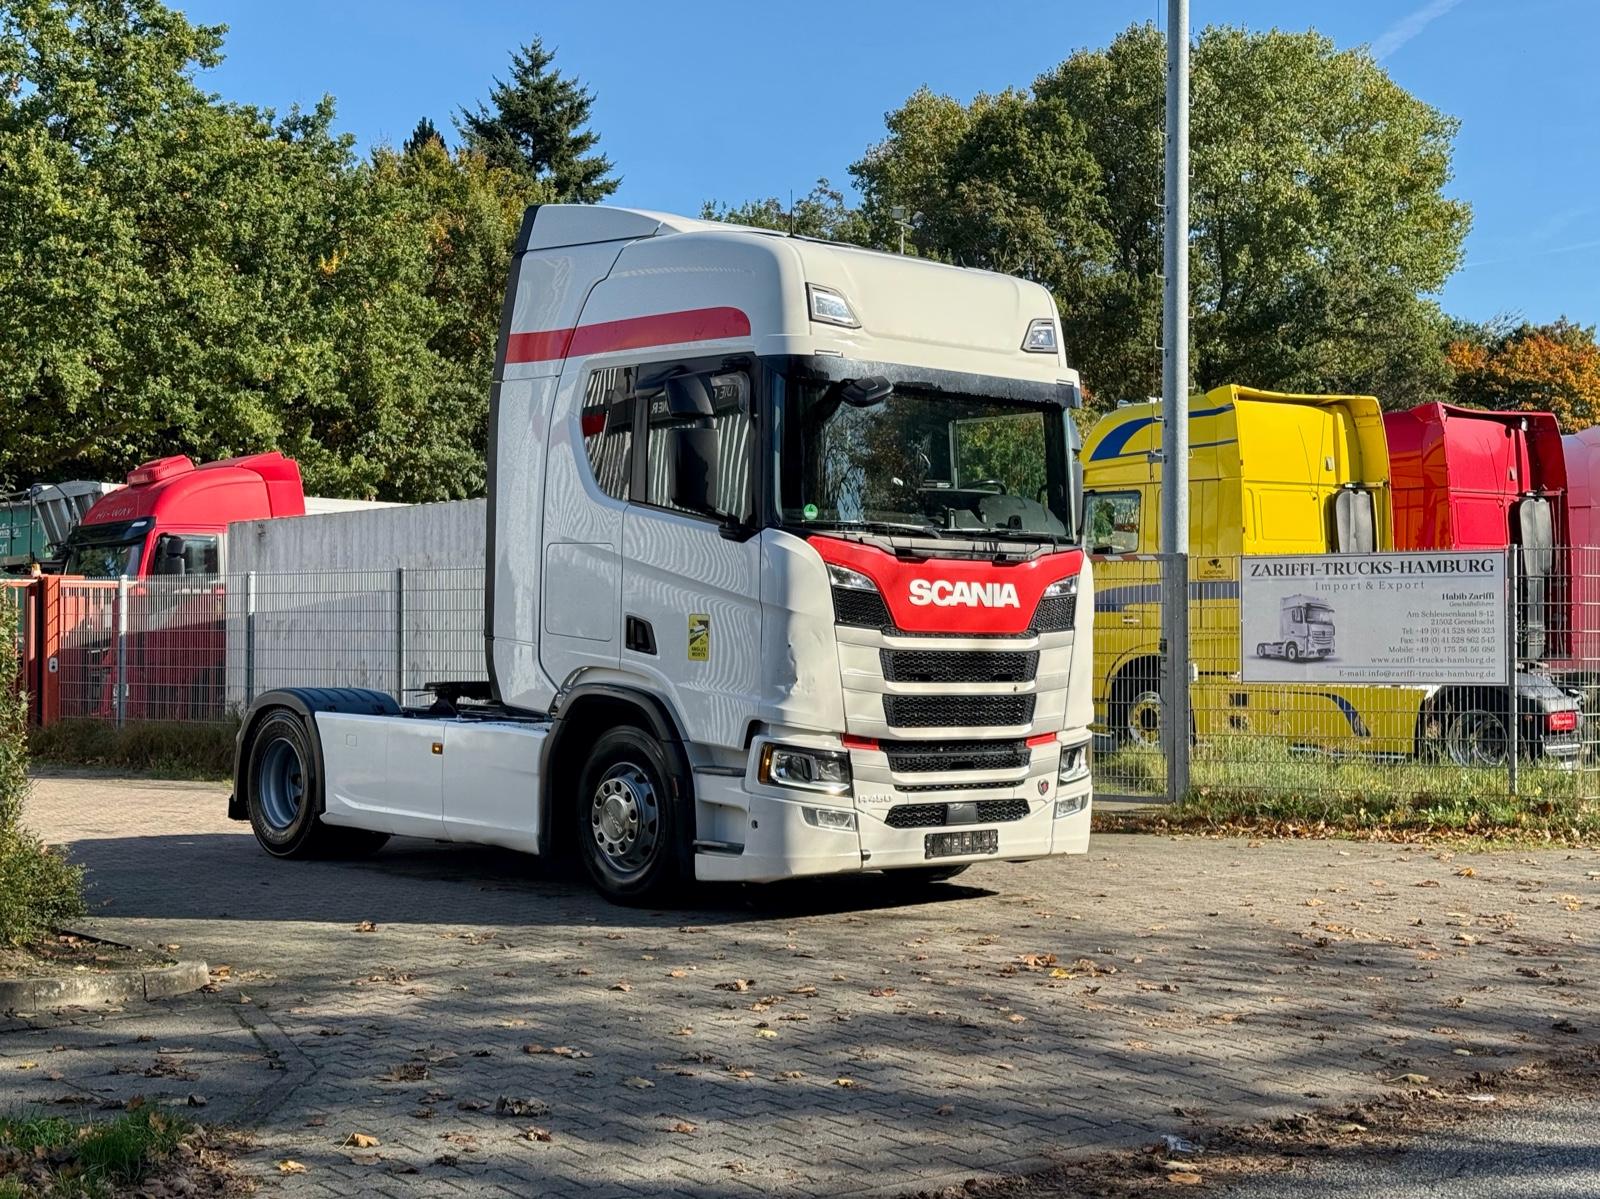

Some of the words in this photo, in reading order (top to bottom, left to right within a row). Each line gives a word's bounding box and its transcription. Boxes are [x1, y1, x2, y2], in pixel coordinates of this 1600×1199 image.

[1251, 558, 1494, 577] ZARIFFI-TRUCKS-HAMBURG
[908, 578, 1021, 608] SCANIA
[1315, 582, 1361, 592] Import
[1366, 582, 1373, 590] &
[1379, 580, 1425, 592] Export
[1442, 592, 1467, 600] Habib
[1469, 592, 1495, 600] Zariffi
